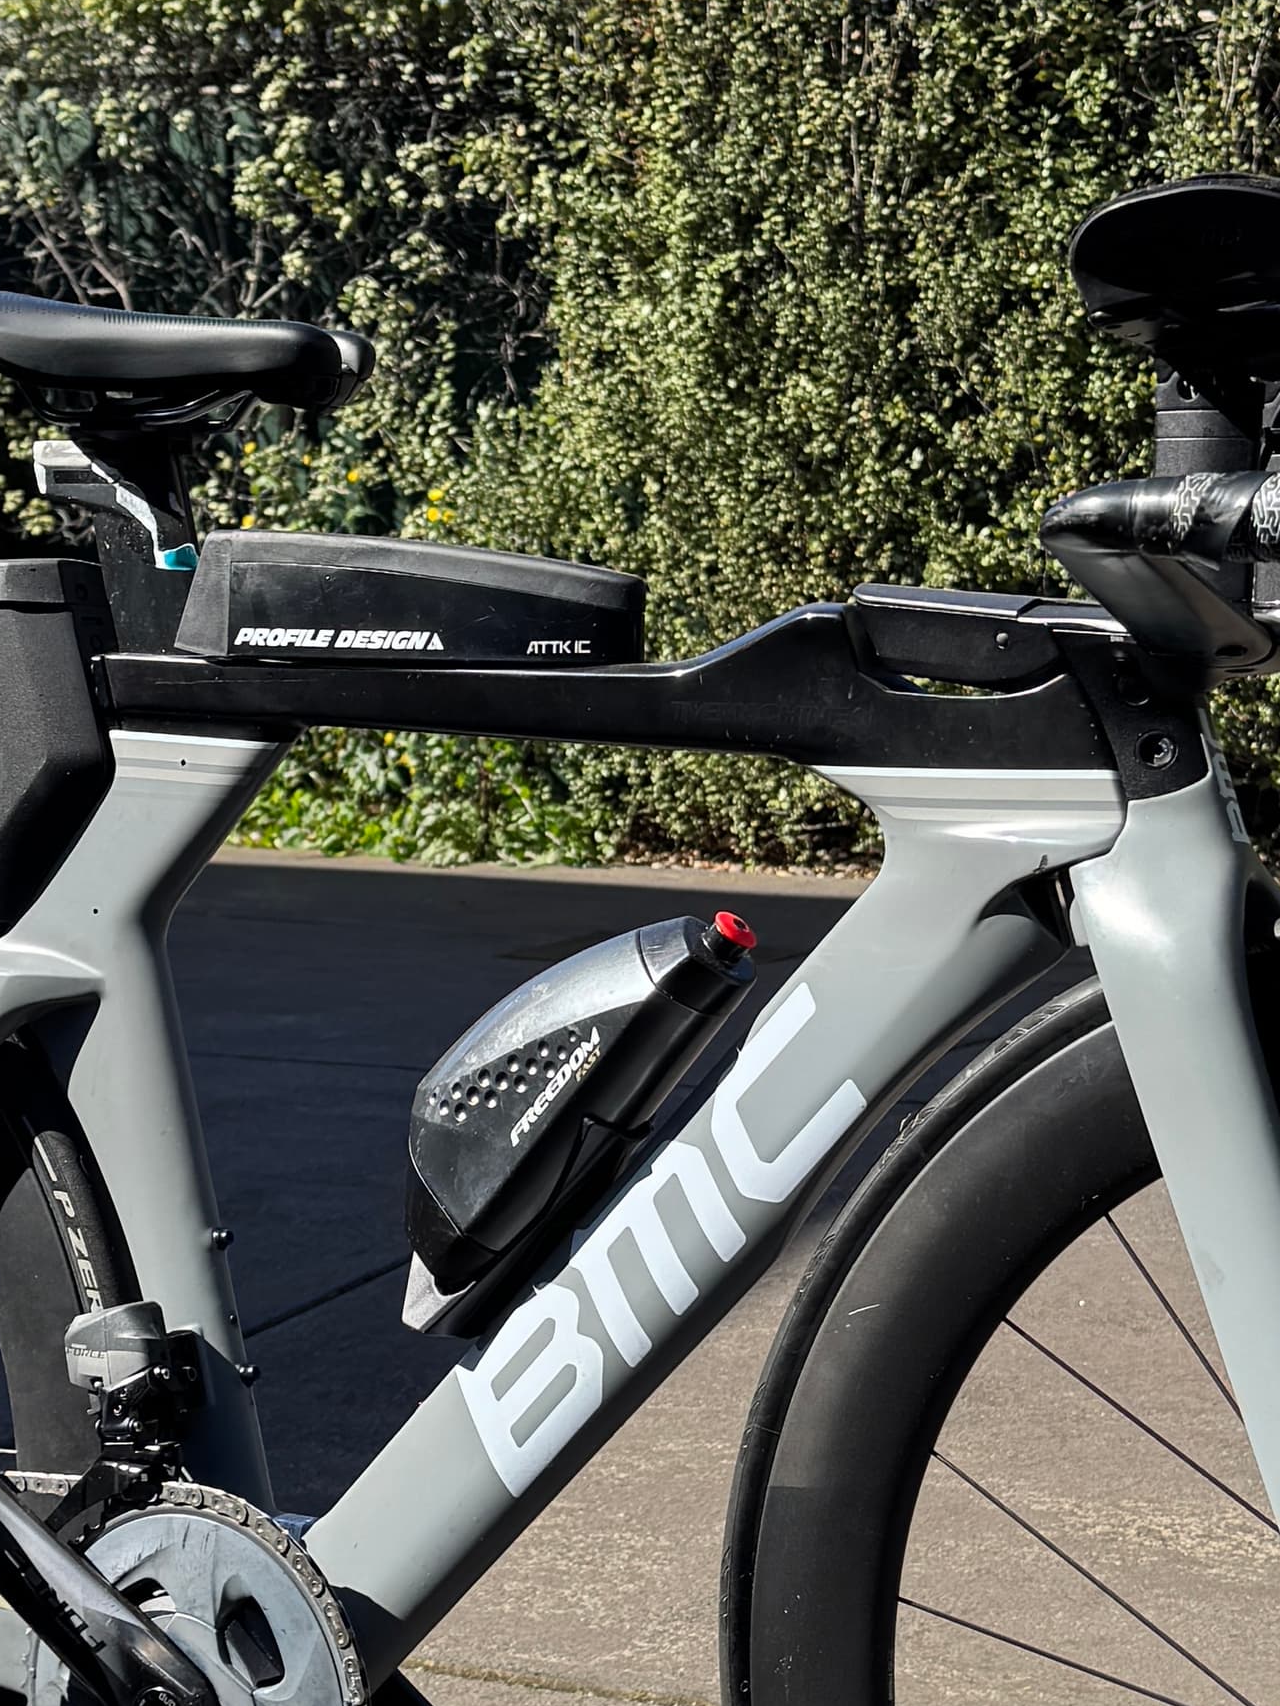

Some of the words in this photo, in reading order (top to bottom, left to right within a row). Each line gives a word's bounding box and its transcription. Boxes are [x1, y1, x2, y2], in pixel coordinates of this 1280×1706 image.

[233, 627, 332, 648] PROFILE
[334, 630, 431, 650] DESIGN
[510, 1026, 601, 1147] FREEDOM
[575, 1044, 601, 1082] FAST
[53, 1189, 75, 1219] P
[68, 1227, 104, 1313] ZER
[456, 981, 868, 1498] BMC
